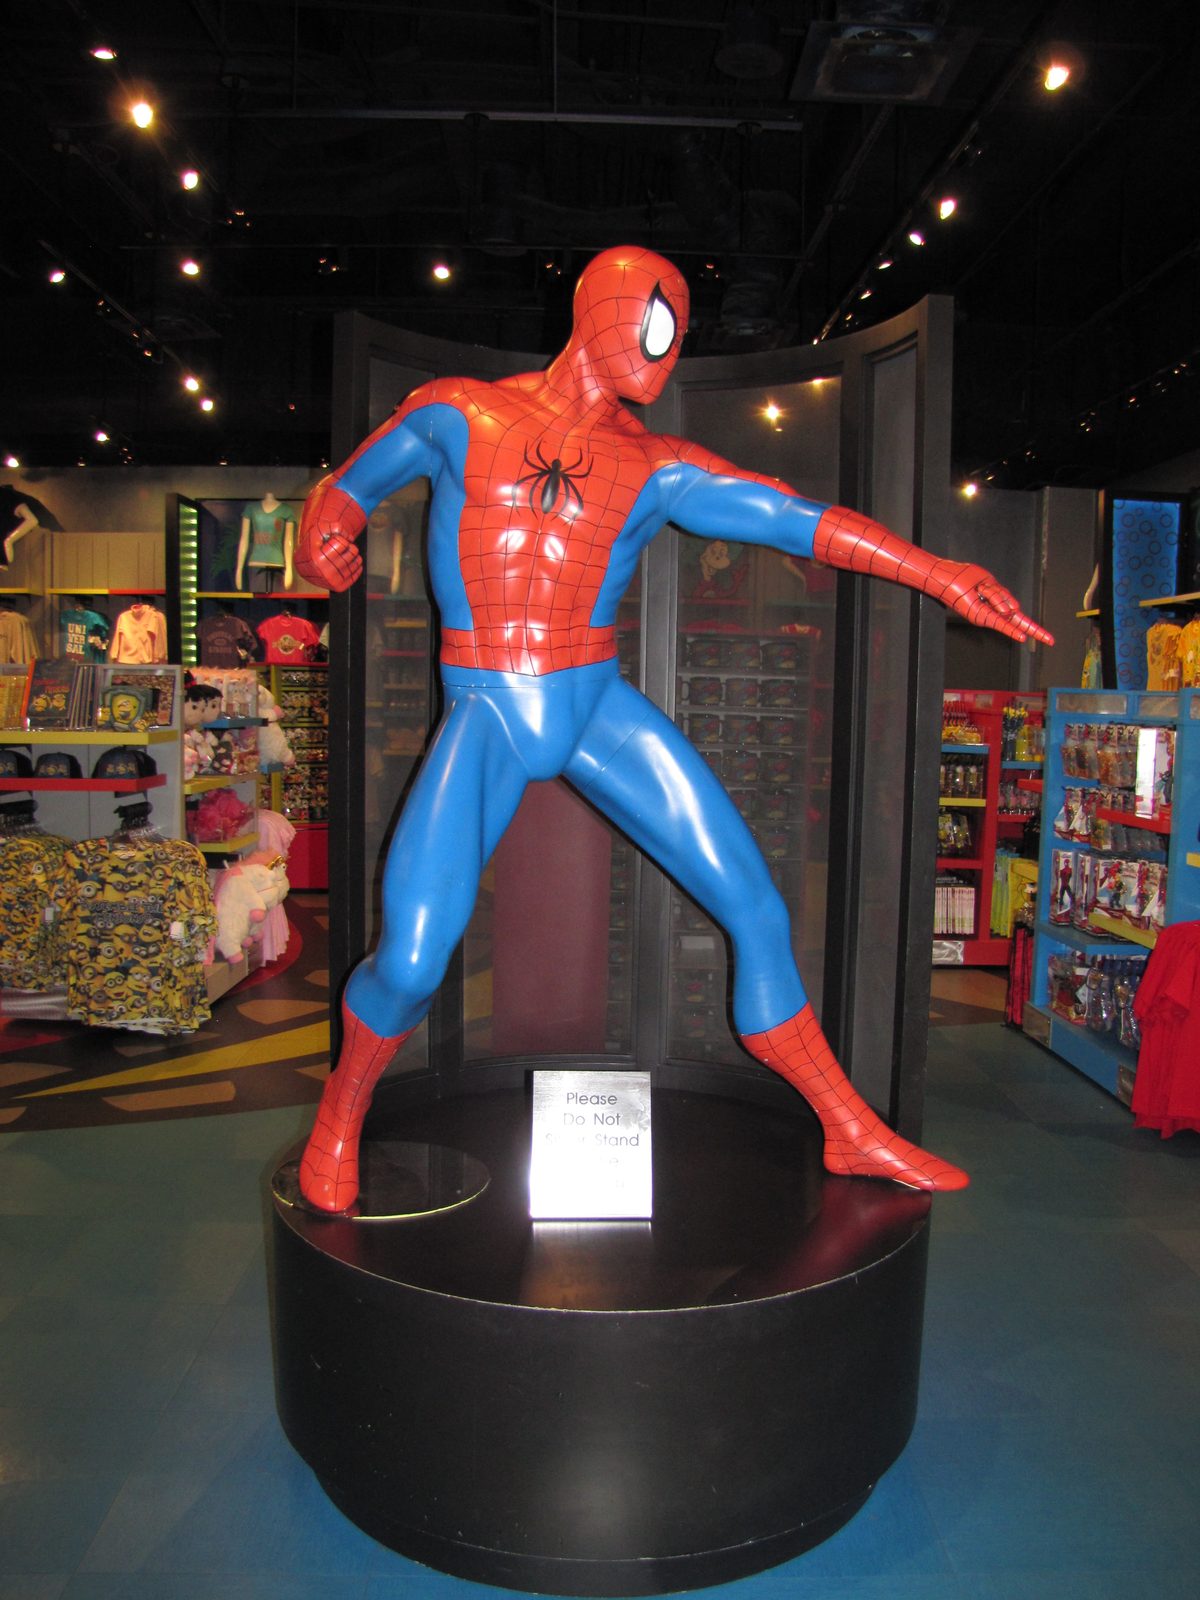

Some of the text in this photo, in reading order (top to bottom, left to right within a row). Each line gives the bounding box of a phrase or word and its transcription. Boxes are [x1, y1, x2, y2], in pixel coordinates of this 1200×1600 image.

[66, 643, 85, 655] SAL
[566, 1092, 618, 1105] Please
[563, 1112, 621, 1126] Do Not
[595, 1133, 640, 1147] Stand
